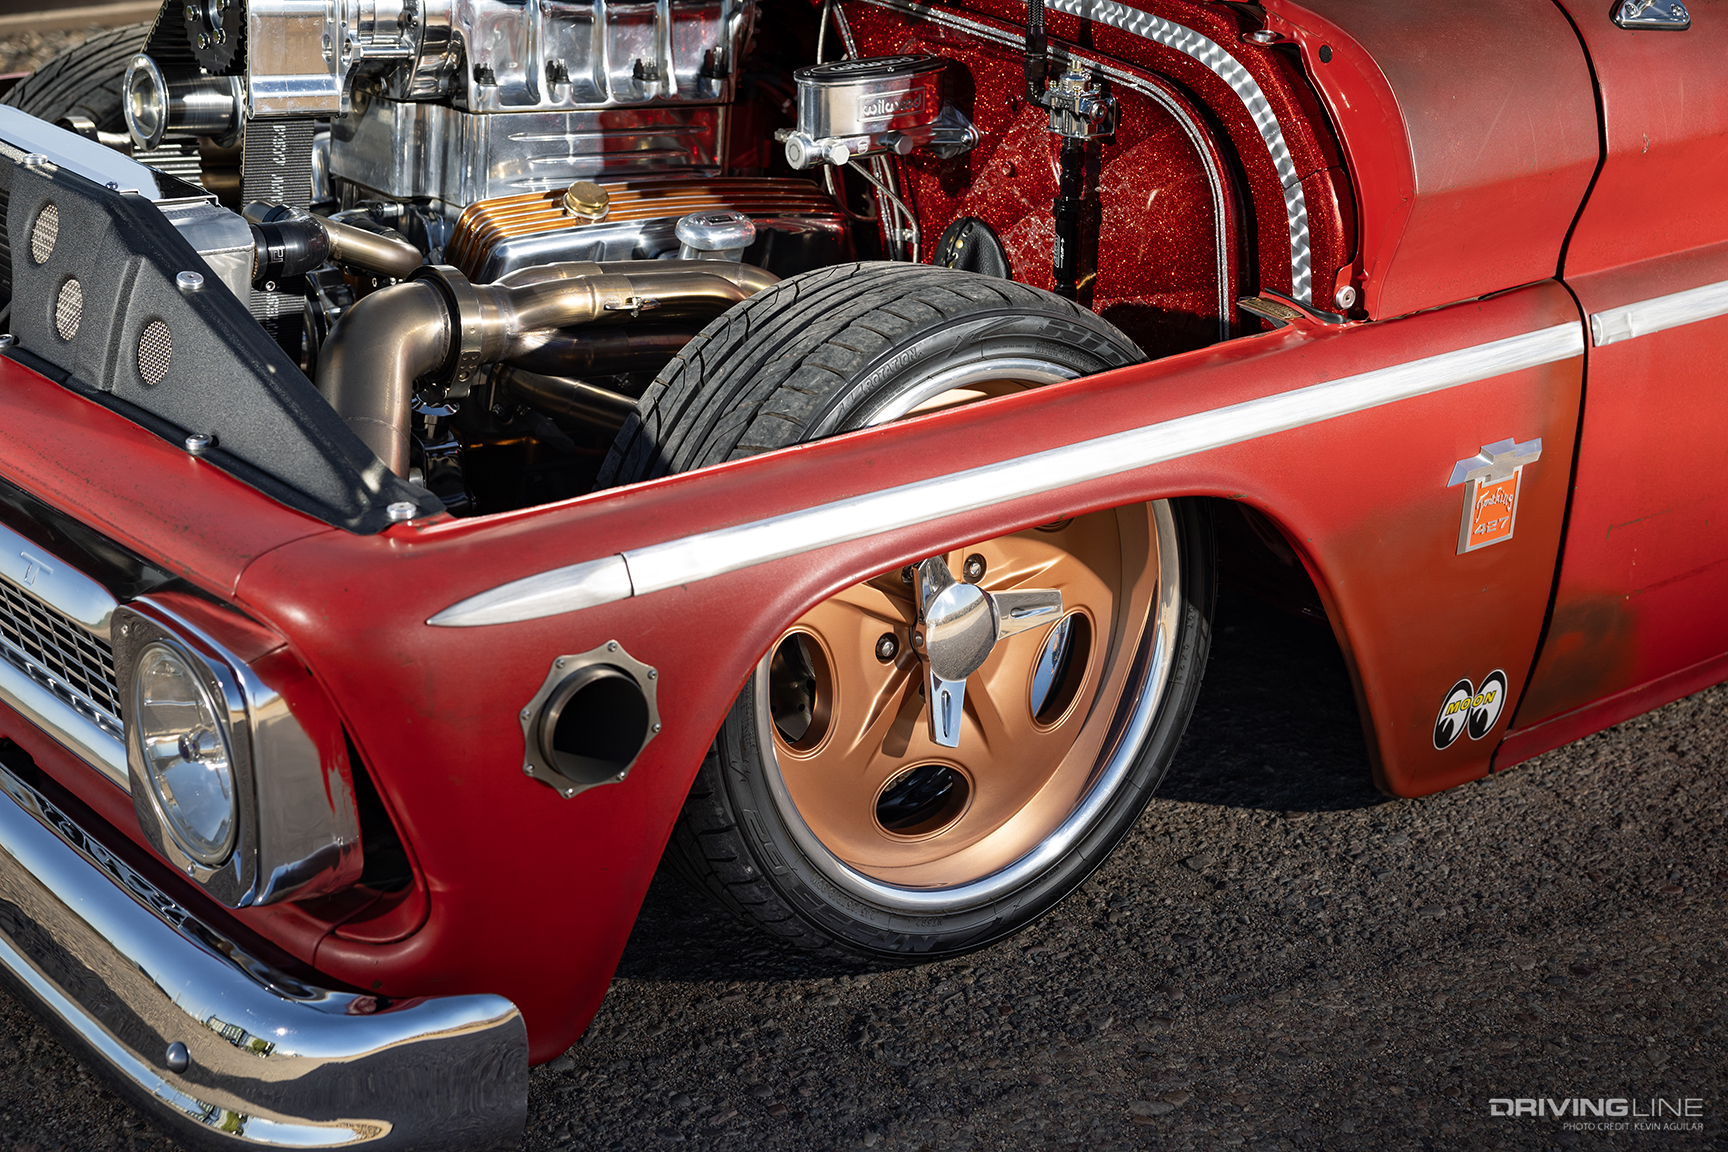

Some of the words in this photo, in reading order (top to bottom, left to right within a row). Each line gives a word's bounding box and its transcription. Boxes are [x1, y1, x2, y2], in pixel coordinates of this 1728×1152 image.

[862, 94, 922, 116] wilwood
[861, 346, 920, 390] ROTATION
[1473, 516, 1509, 535] 427
[1445, 690, 1497, 716] MOON
